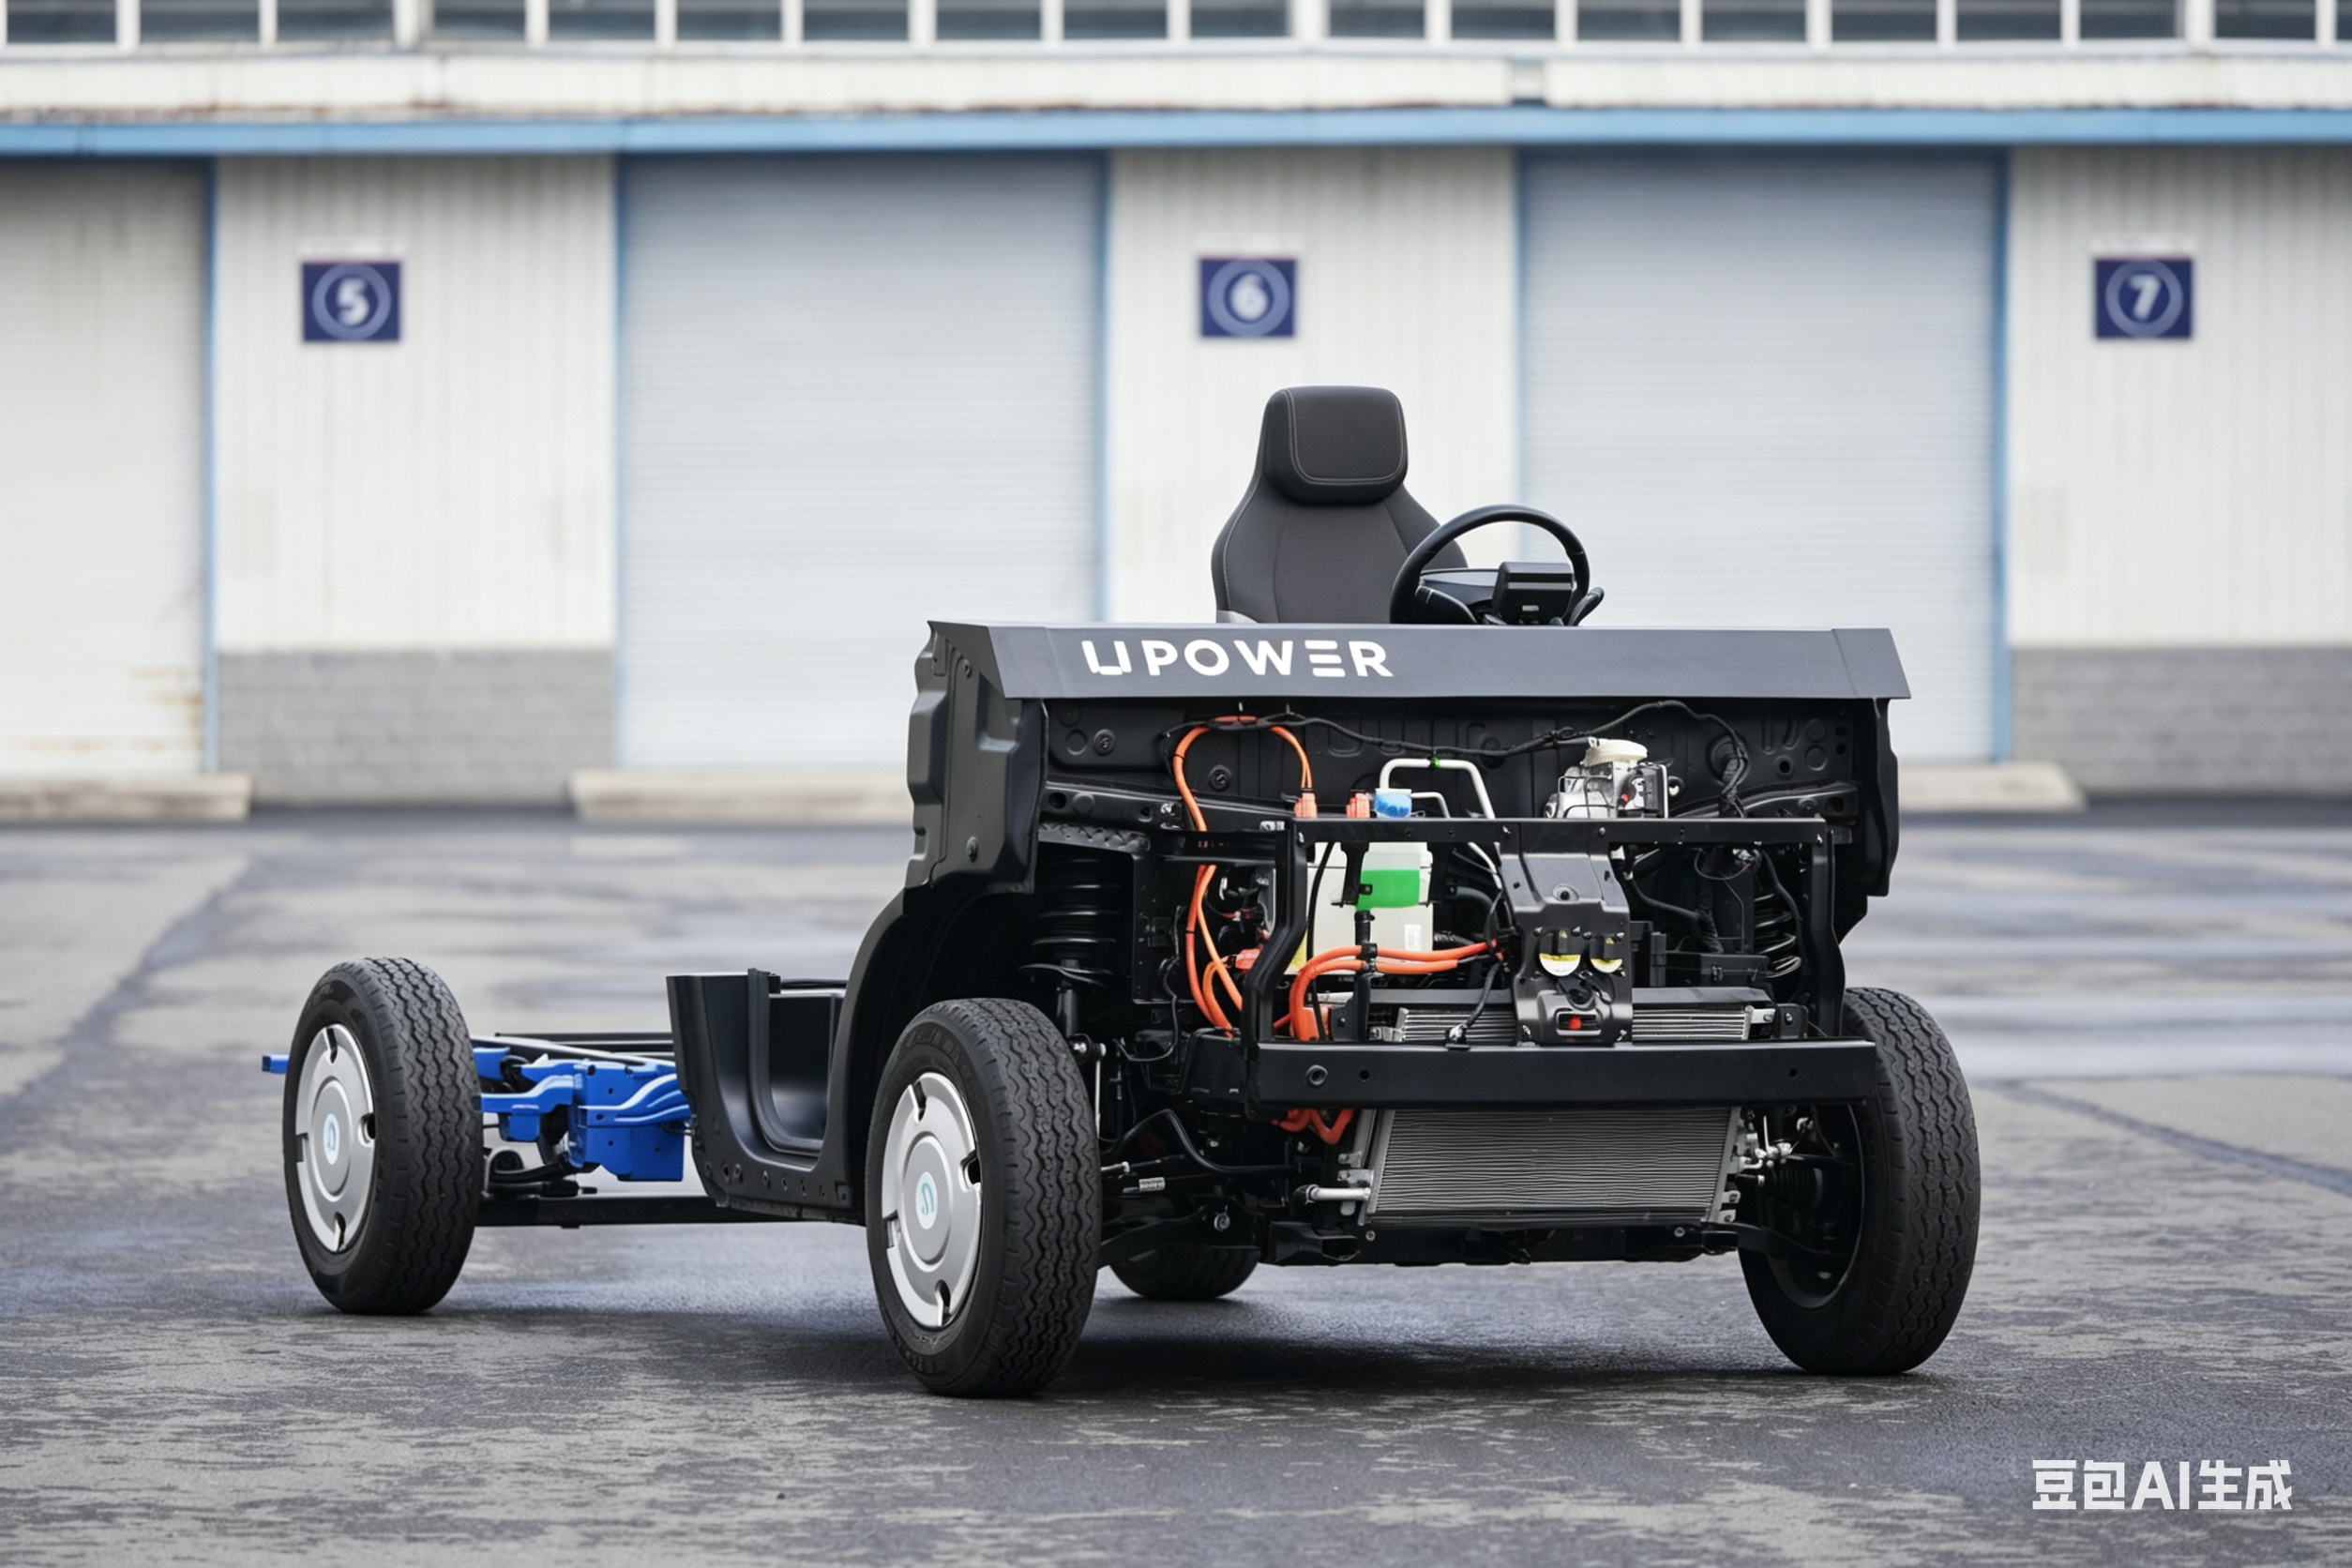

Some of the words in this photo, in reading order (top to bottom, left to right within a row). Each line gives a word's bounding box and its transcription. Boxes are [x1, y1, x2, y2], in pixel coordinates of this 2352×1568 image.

[338, 278, 370, 326] 5
[1230, 273, 1268, 320] 6
[2129, 273, 2161, 319] 7
